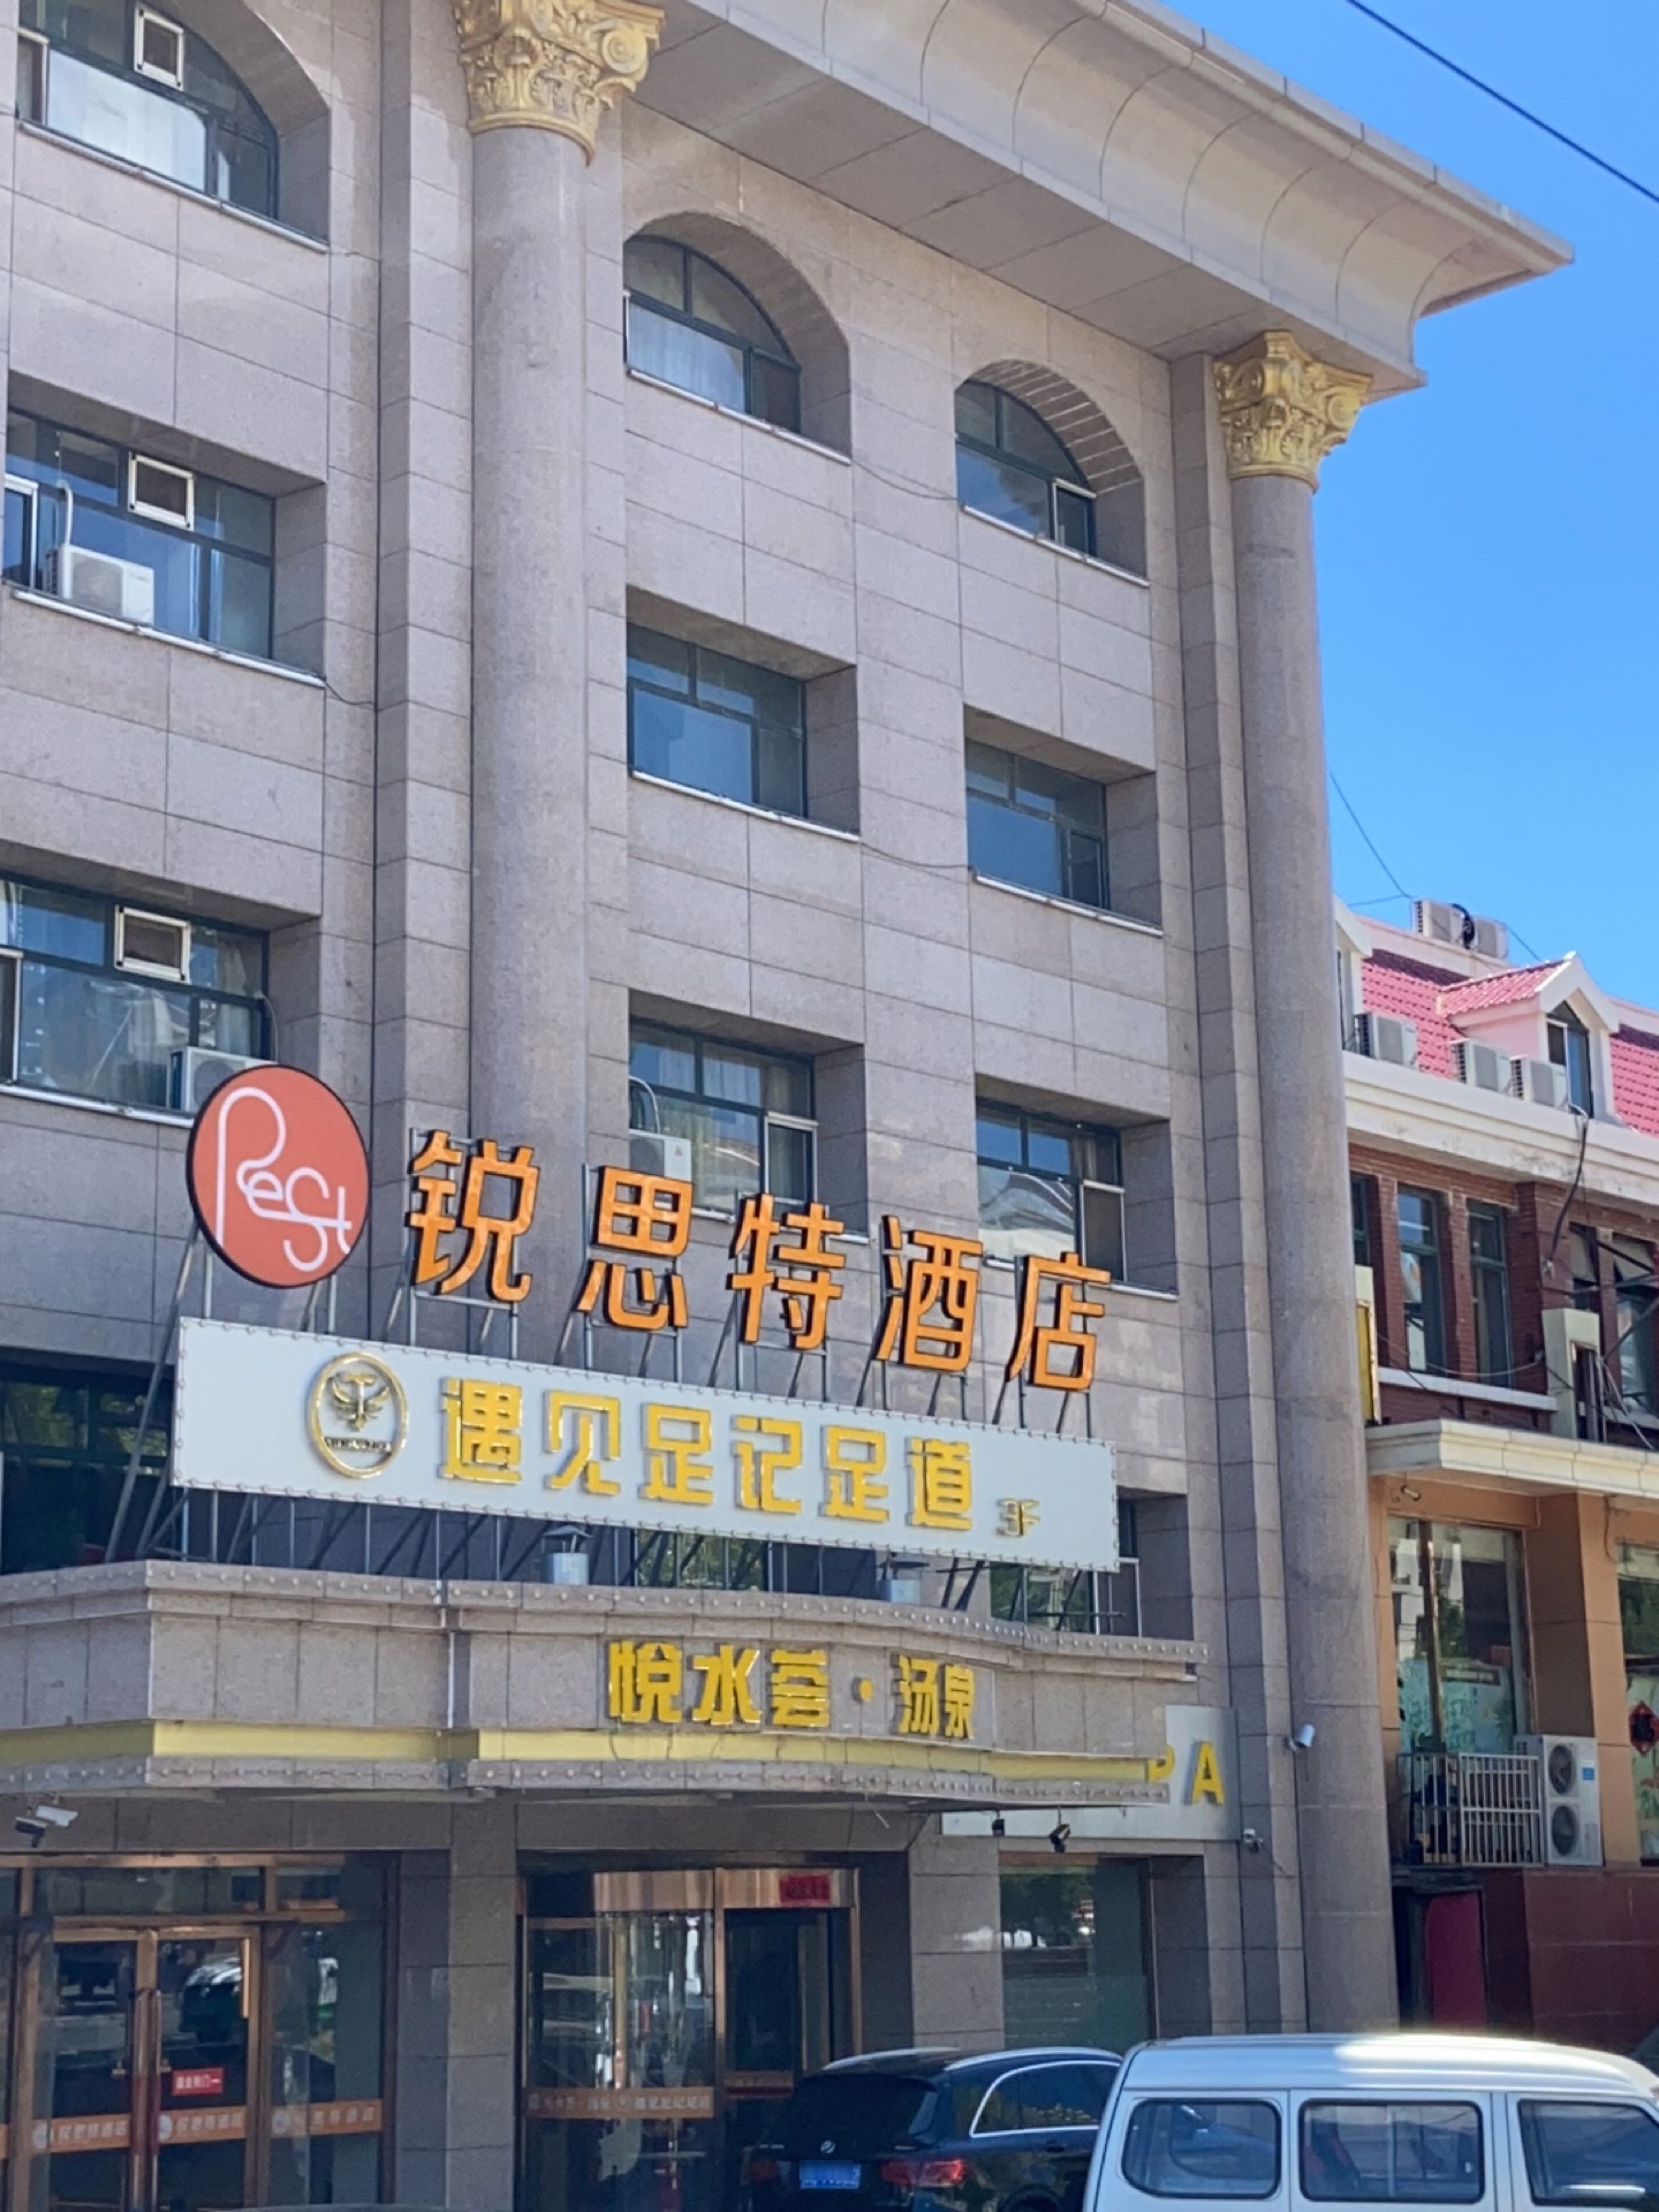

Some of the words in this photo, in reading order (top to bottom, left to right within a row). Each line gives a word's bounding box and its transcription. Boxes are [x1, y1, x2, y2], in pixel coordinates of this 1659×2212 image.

[410, 1130, 1110, 1392] 锐思特酒店
[442, 1377, 972, 1530] 遇见足记足道
